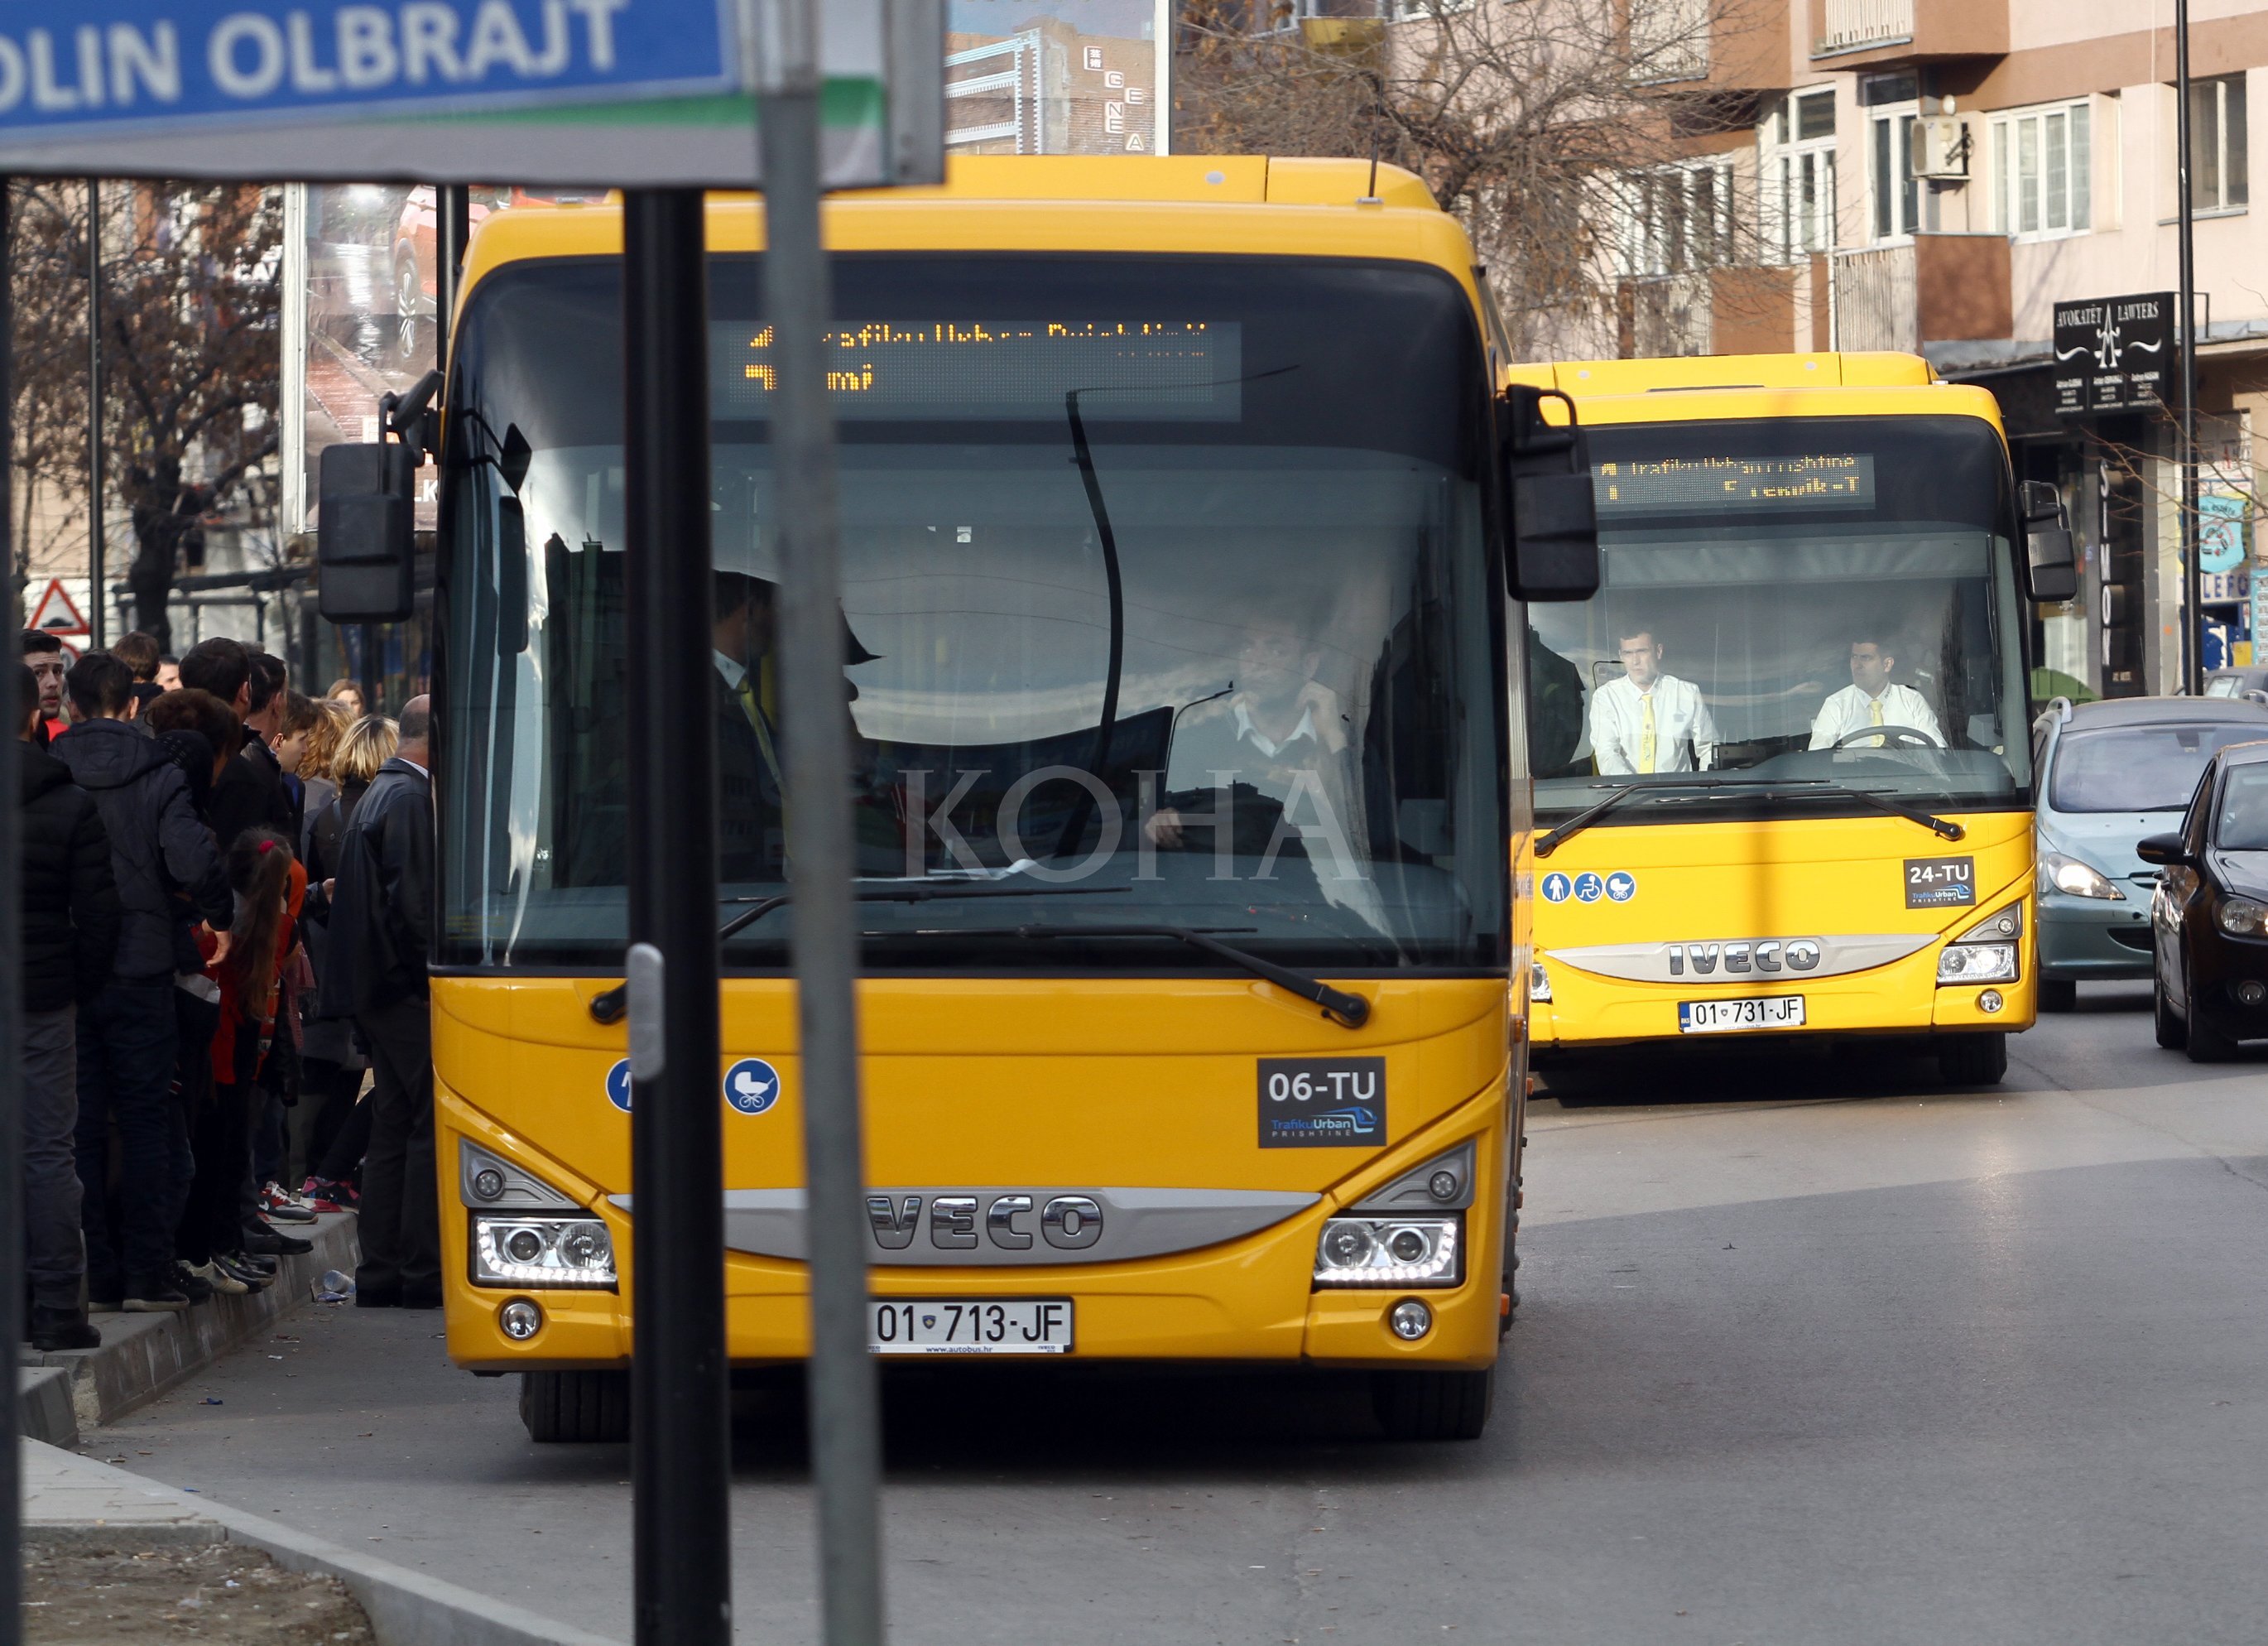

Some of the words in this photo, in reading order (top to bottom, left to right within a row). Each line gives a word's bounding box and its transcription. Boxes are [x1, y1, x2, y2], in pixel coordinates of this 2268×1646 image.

[208, 0, 627, 99] OLBRAJT
[2117, 301, 2159, 322] LAWYERS
[1910, 864, 1969, 883] 24-TU
[1669, 940, 1820, 975] IVECO
[1695, 1003, 1718, 1025] 01
[1732, 999, 1799, 1023] 731-JF
[1268, 1071, 1376, 1102] 06-TU
[1271, 1119, 1351, 1130] TrafikuUrban
[866, 1196, 1104, 1250] VECO
[877, 1304, 914, 1342] 01
[944, 1304, 1063, 1342] 713-JF
